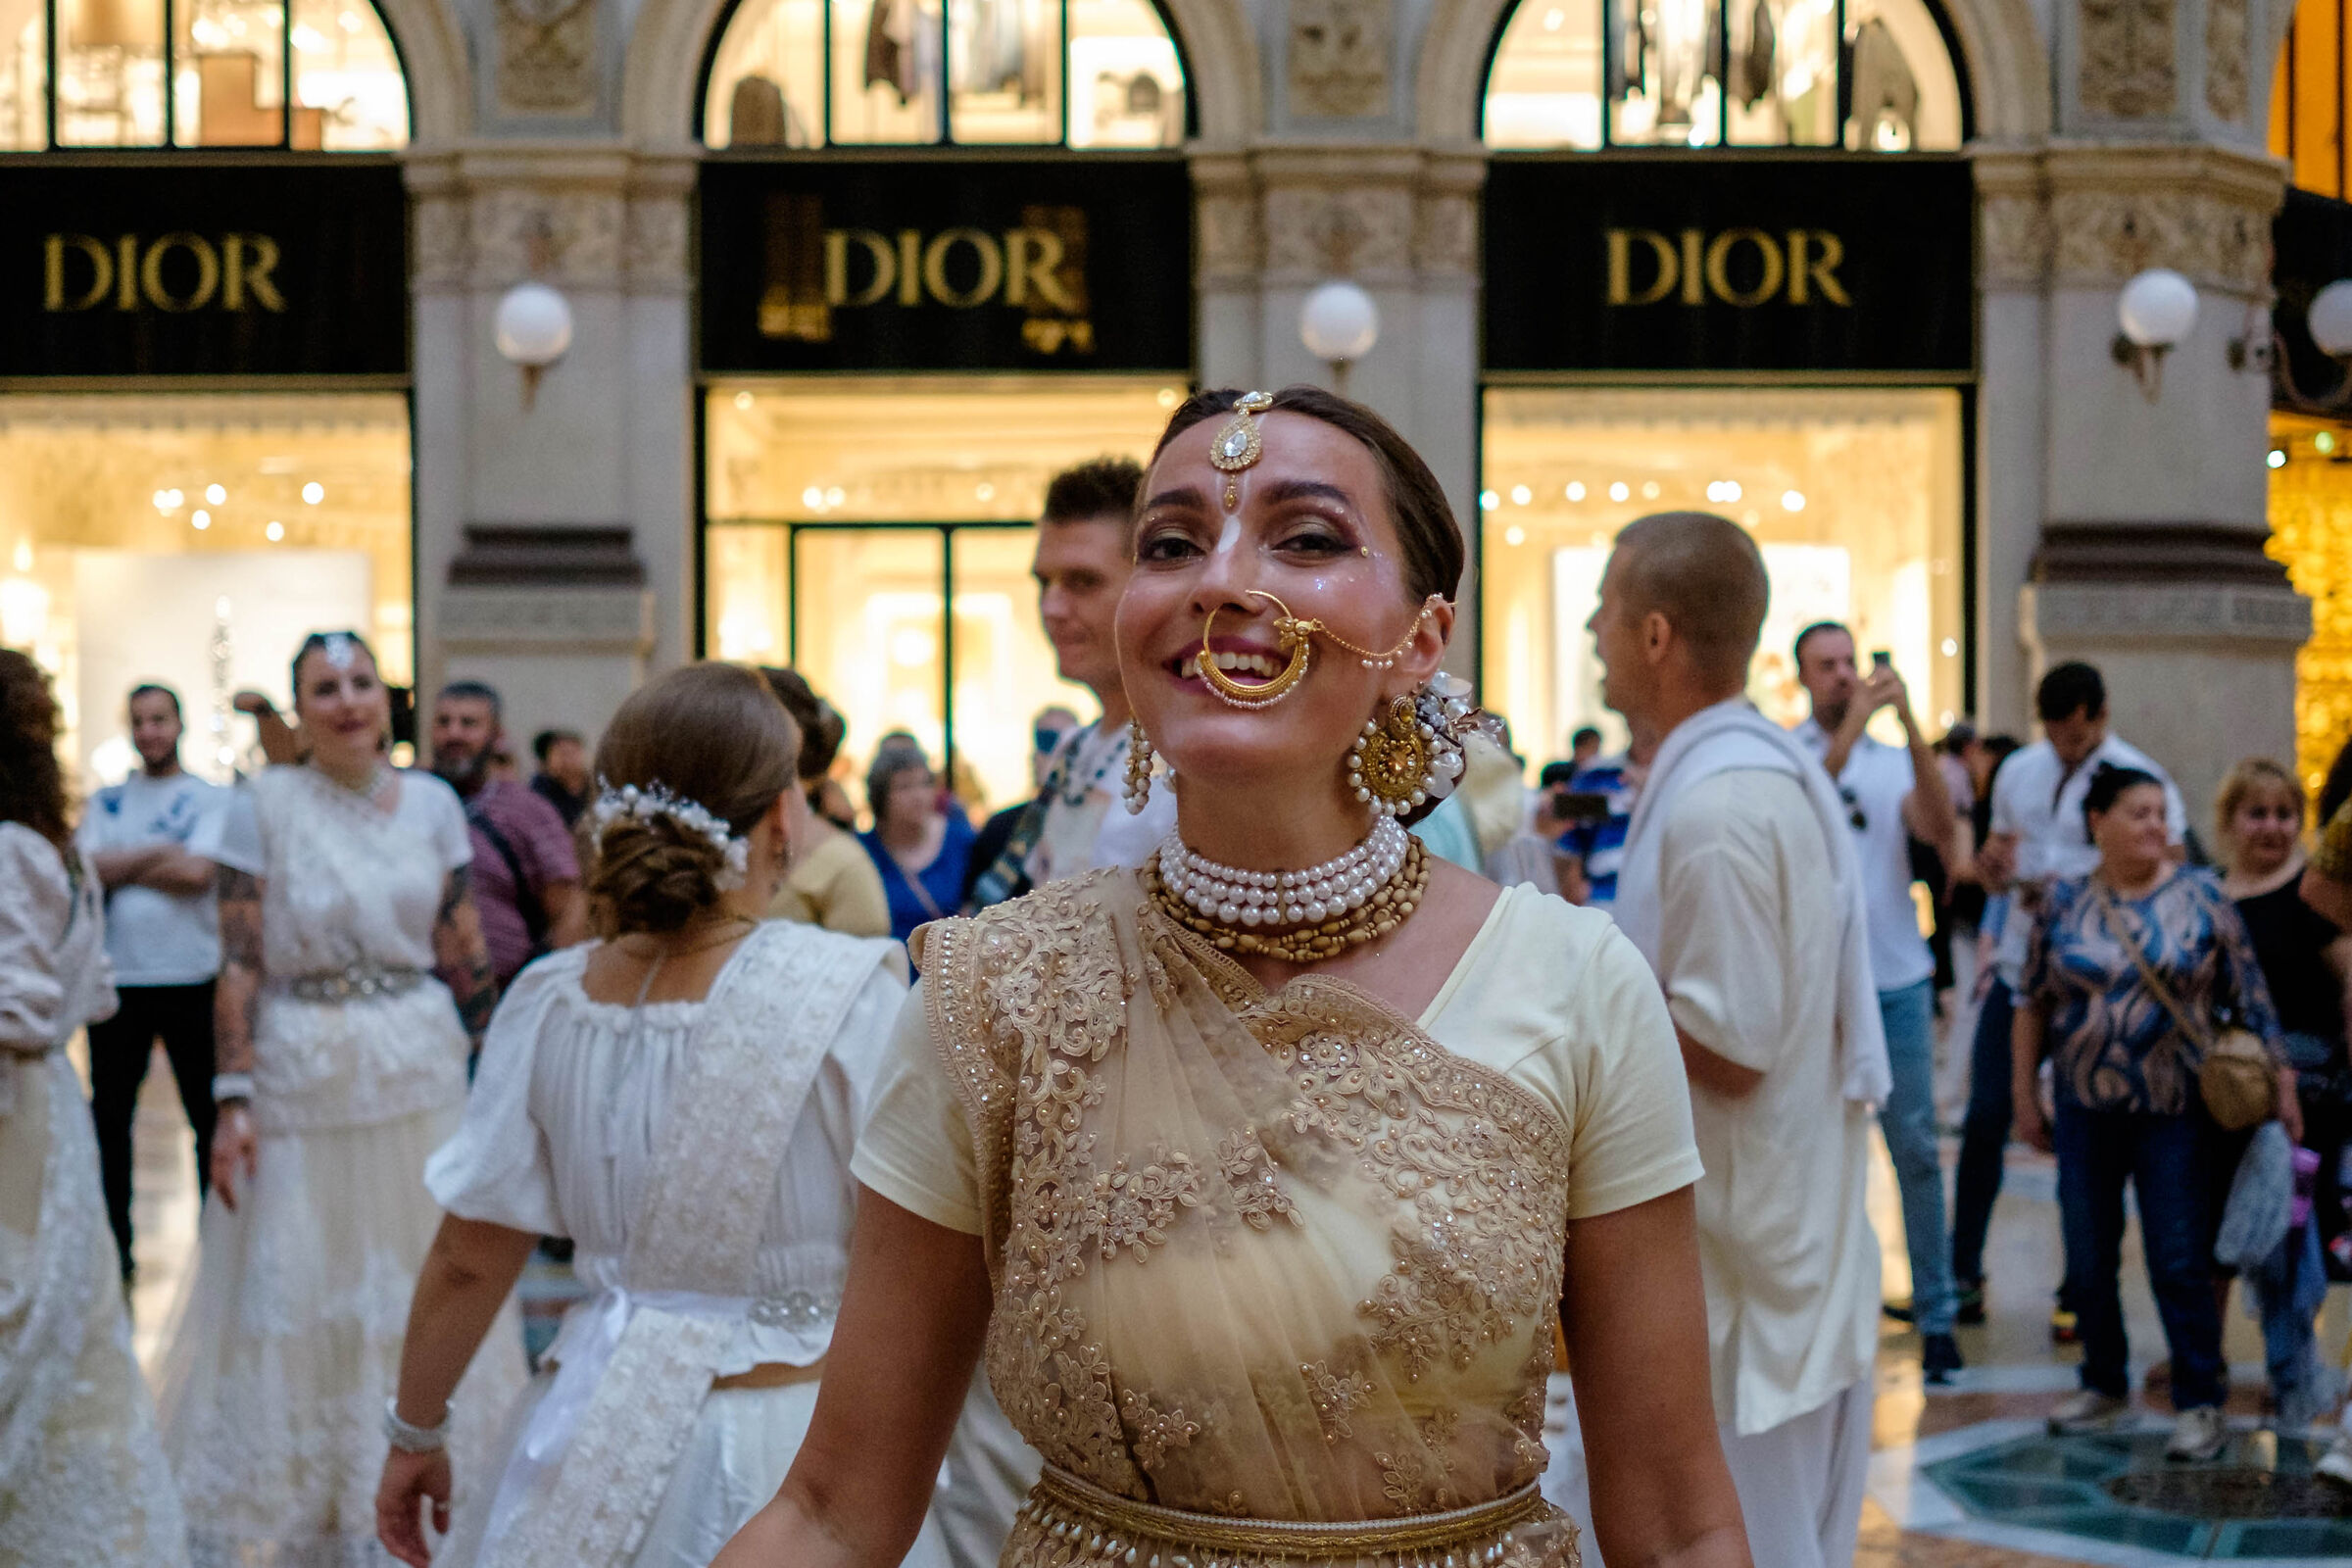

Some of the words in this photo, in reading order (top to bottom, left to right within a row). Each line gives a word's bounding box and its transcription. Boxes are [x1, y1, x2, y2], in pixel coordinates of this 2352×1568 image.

[44, 233, 284, 312] DIOR
[825, 228, 1075, 311] DIOR
[1606, 228, 1850, 306] DIOR
